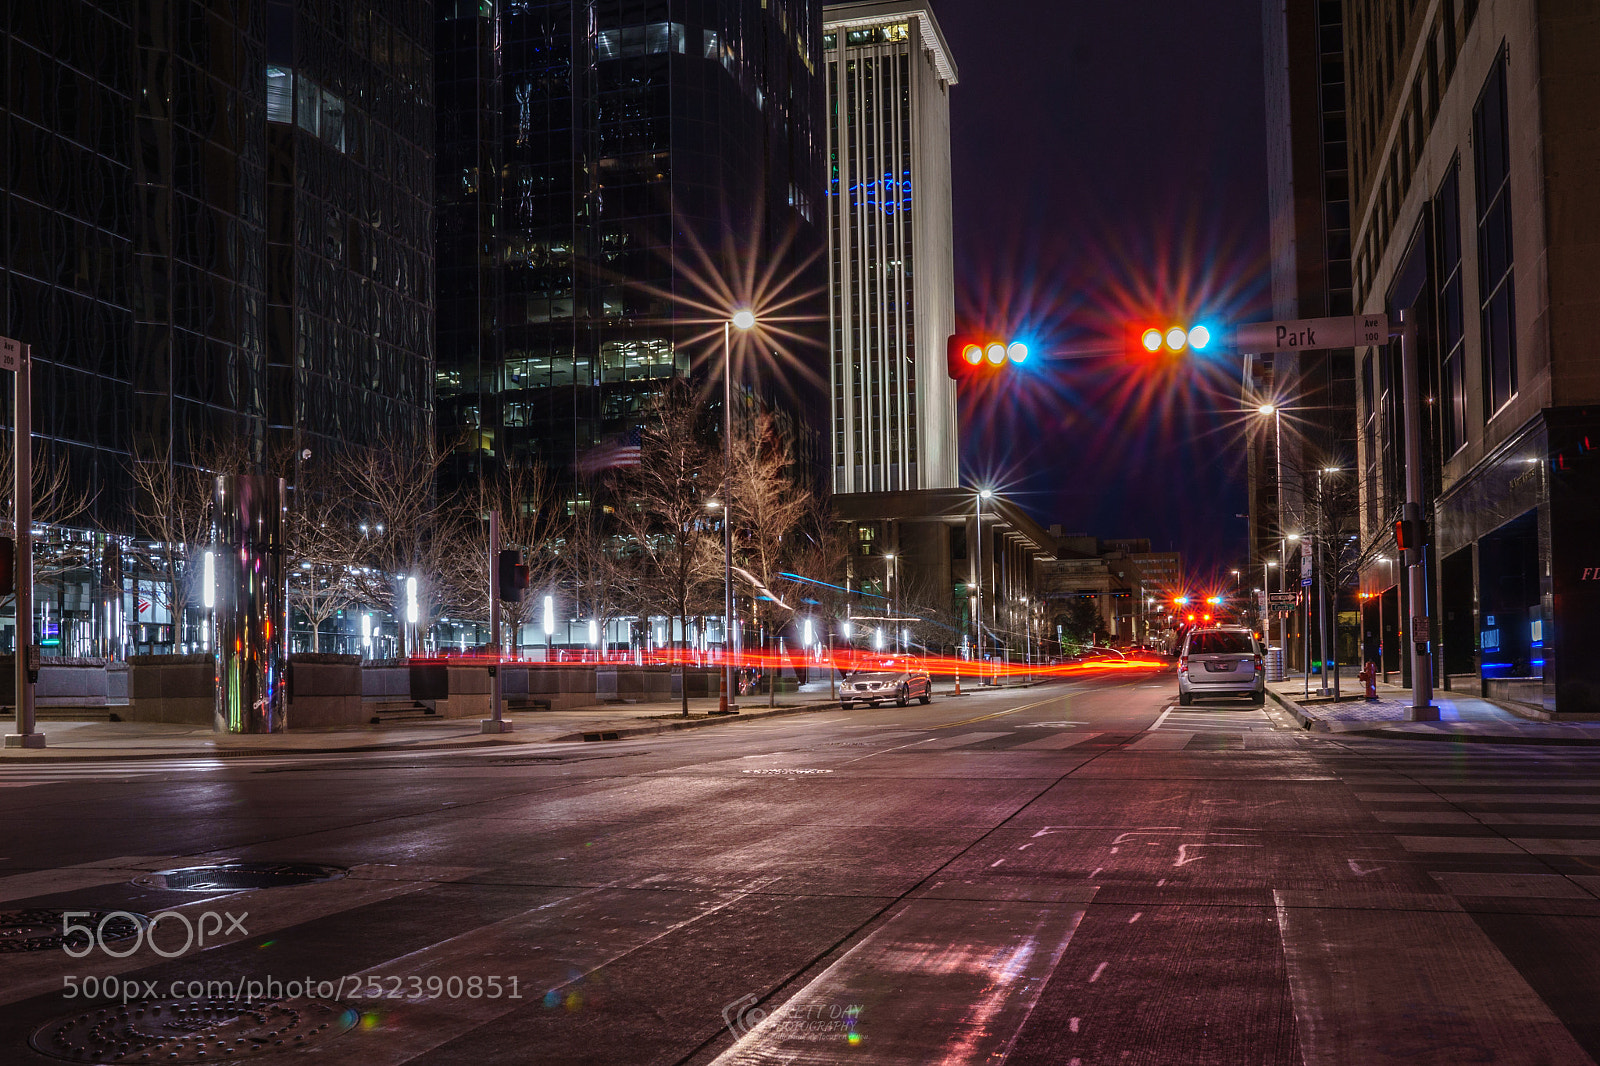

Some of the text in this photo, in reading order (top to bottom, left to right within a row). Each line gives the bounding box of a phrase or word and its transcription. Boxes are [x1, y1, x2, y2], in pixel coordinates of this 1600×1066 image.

[1364, 319, 1379, 328] Ave
[1276, 326, 1316, 348] Park
[1364, 332, 1379, 341] 100
[4, 342, 14, 352] Ave
